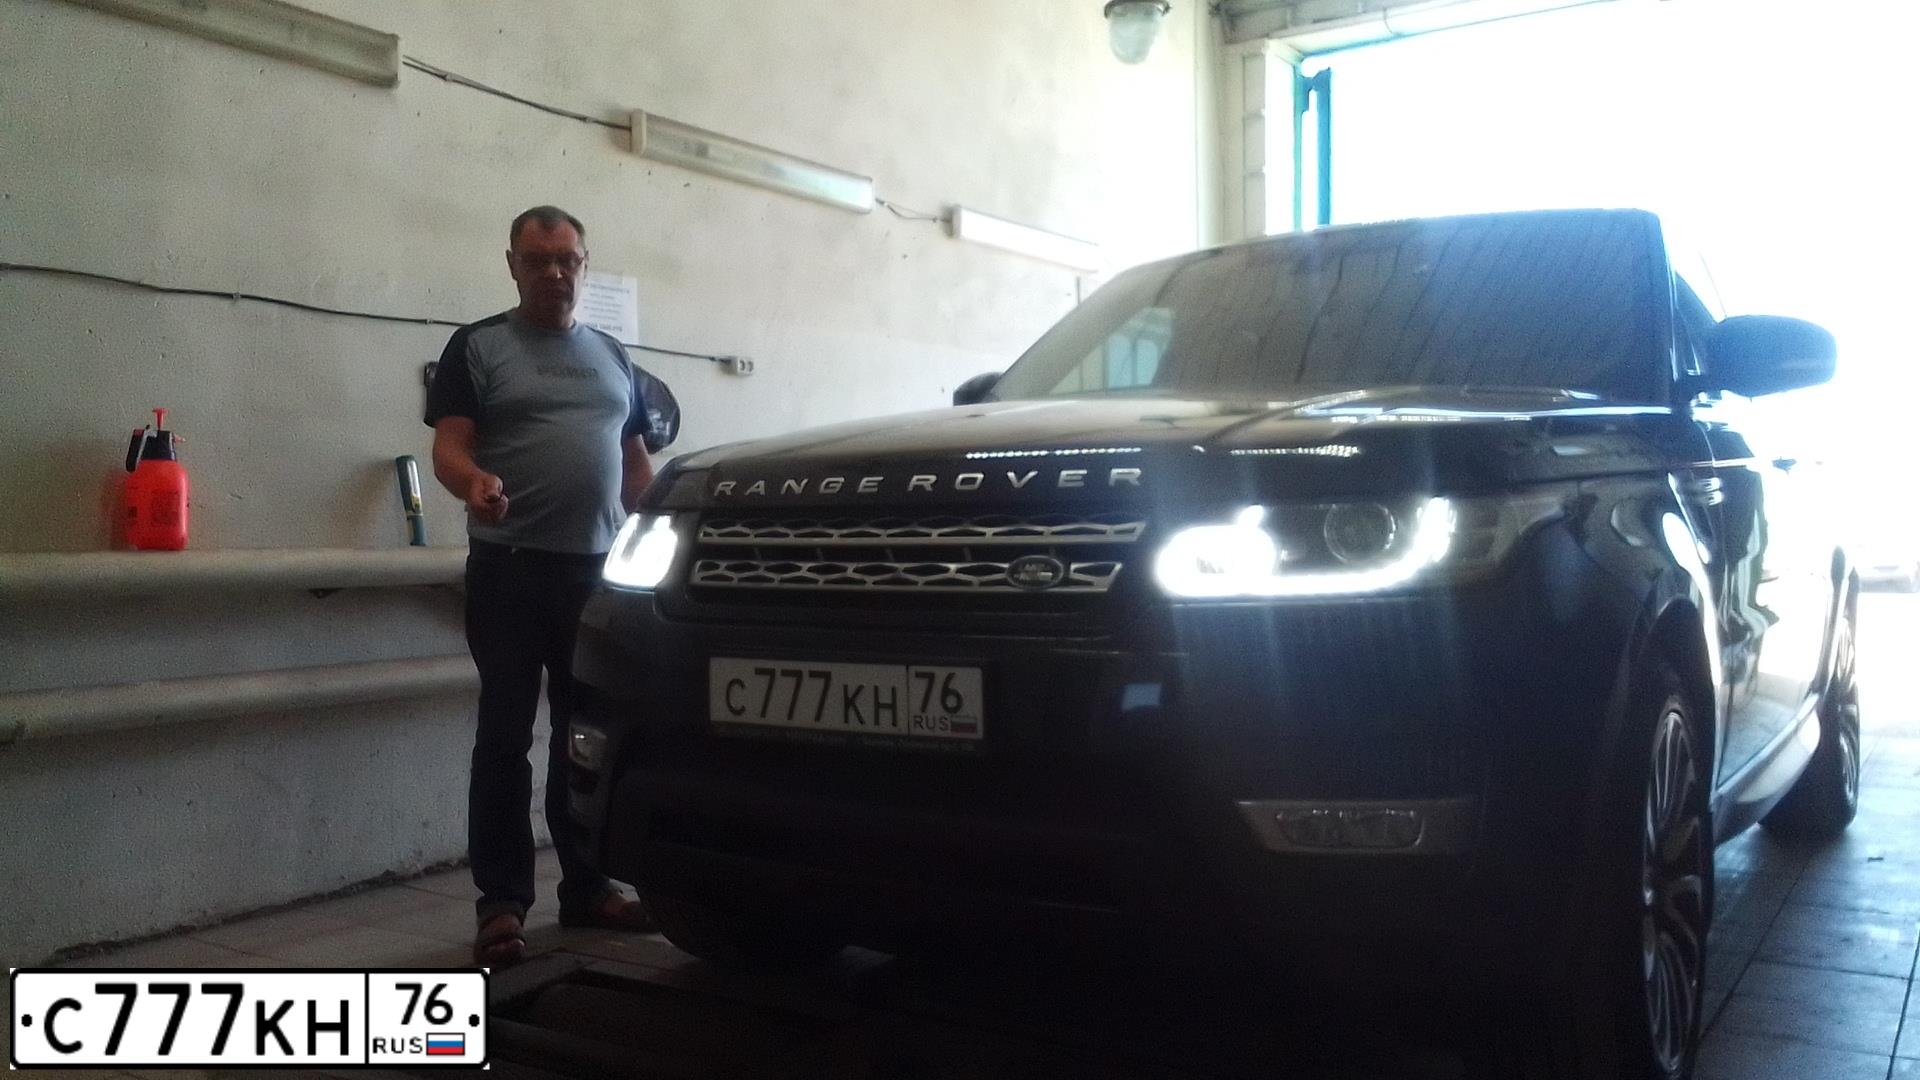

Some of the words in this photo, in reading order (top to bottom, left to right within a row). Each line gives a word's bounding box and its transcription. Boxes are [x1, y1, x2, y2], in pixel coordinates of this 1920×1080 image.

[714, 476, 884, 497] RANGE
[907, 468, 1142, 492] ROVER
[915, 671, 964, 715] 76
[913, 715, 949, 732] RUS
